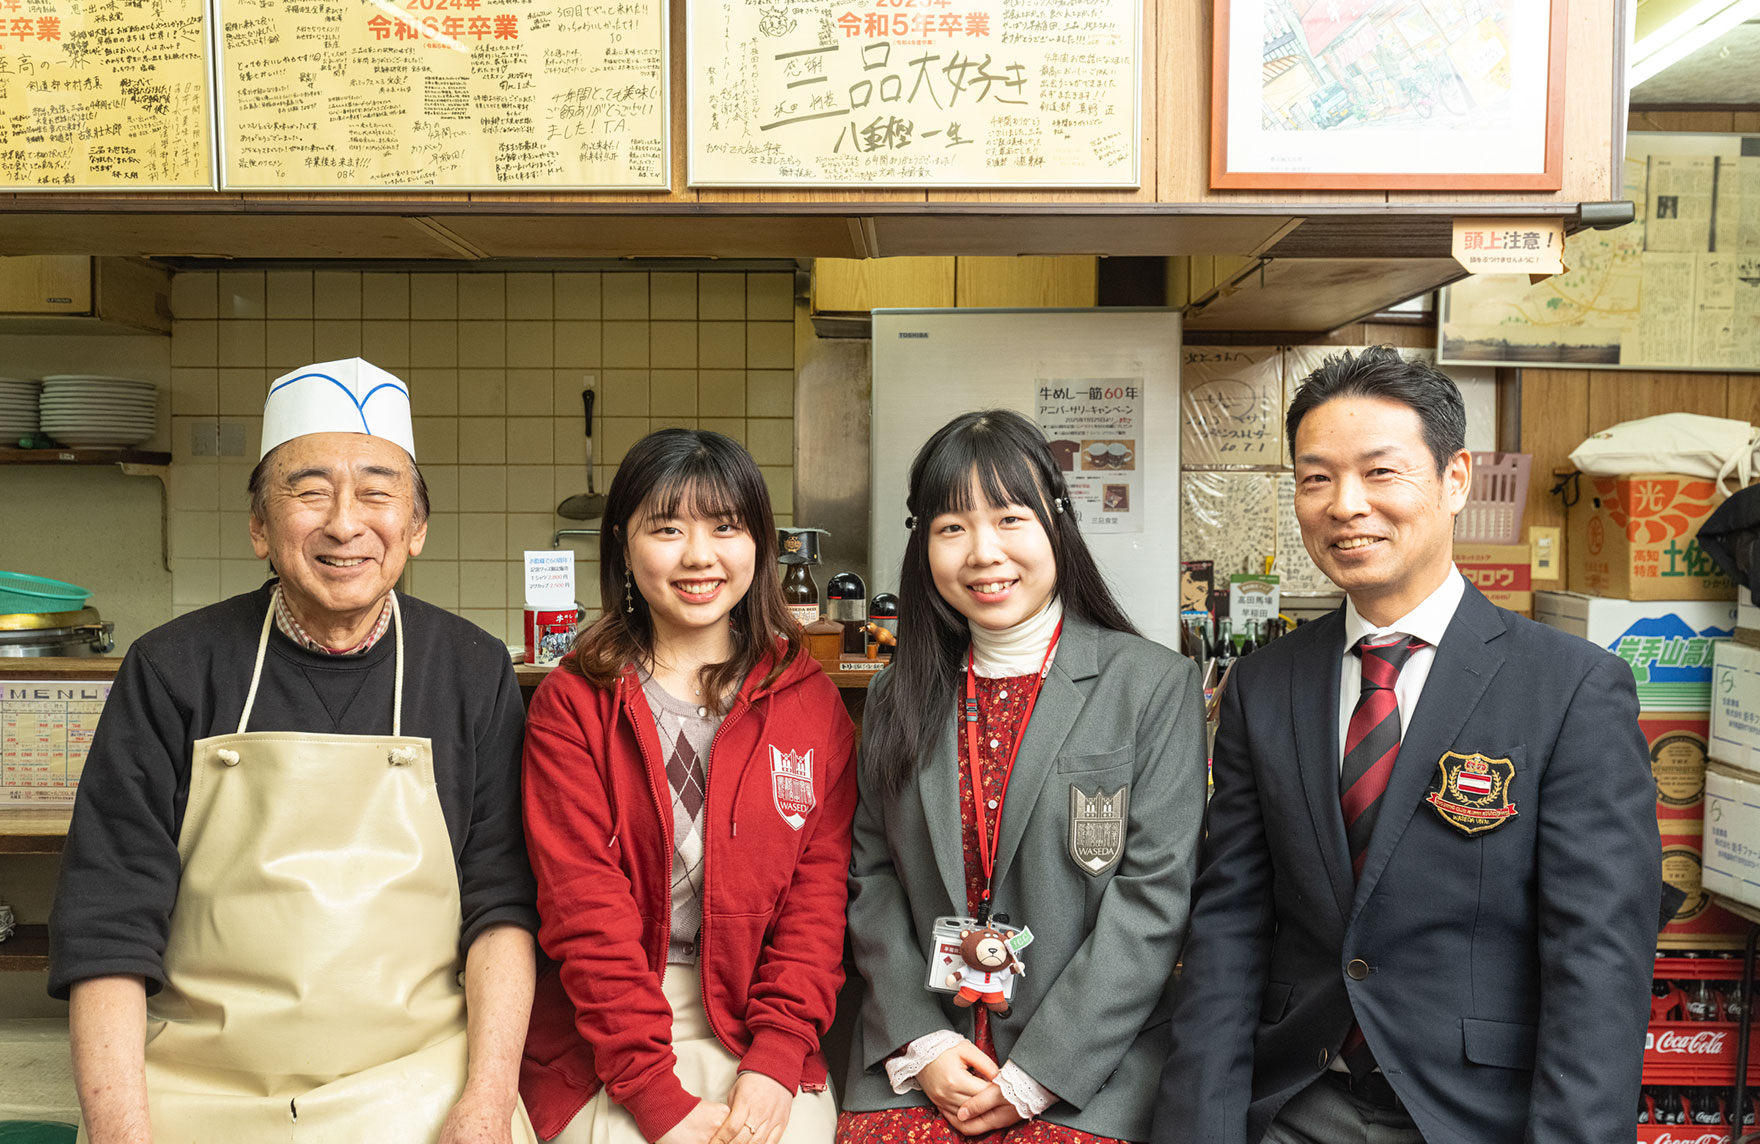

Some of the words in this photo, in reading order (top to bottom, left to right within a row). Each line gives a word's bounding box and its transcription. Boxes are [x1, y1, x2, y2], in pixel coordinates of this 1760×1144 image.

[368, 14, 519, 41] 令和6年卒業
[837, 12, 990, 38] 令和5年卒業
[1464, 231, 1554, 250] 頭上注意!
[1040, 386, 1138, 400] 牛めし一筋60年
[1040, 405, 1133, 415] アニバーサリーキャンペーン
[1634, 482, 1665, 513] 光
[1633, 549, 1660, 562] 高知
[1633, 565, 1660, 578] 特産
[10, 689, 98, 699] MENU
[1078, 847, 1115, 855] WASEDA
[1656, 1030, 1727, 1054] Coca-Cola
